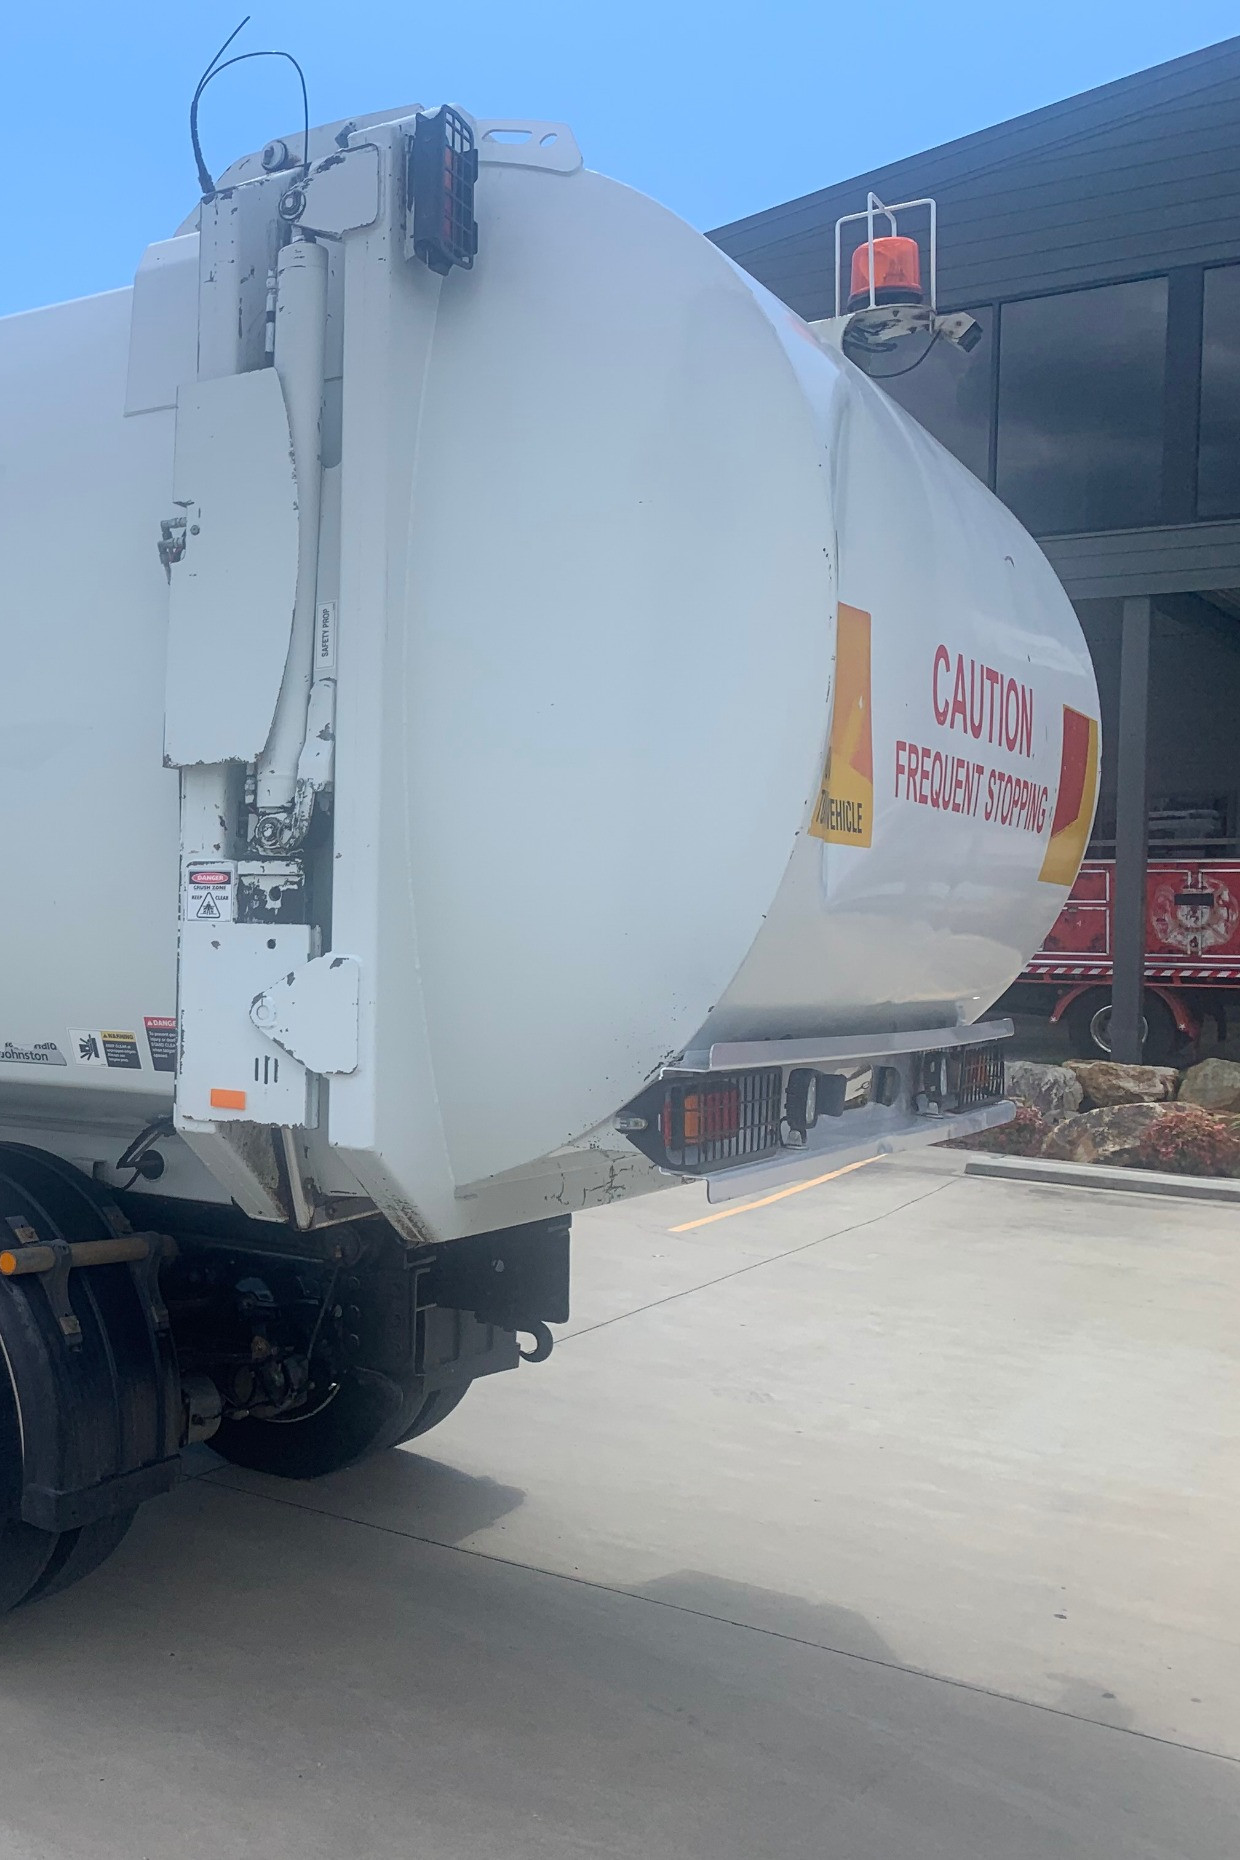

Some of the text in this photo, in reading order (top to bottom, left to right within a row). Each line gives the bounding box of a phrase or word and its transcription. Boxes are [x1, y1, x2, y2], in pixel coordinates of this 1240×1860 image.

[321, 608, 330, 658] SAFETY PROP
[932, 644, 1033, 758] CAUTION
[895, 740, 984, 817] FREQUENT
[984, 769, 1048, 833] STOPPING
[152, 1019, 176, 1027] DANGE
